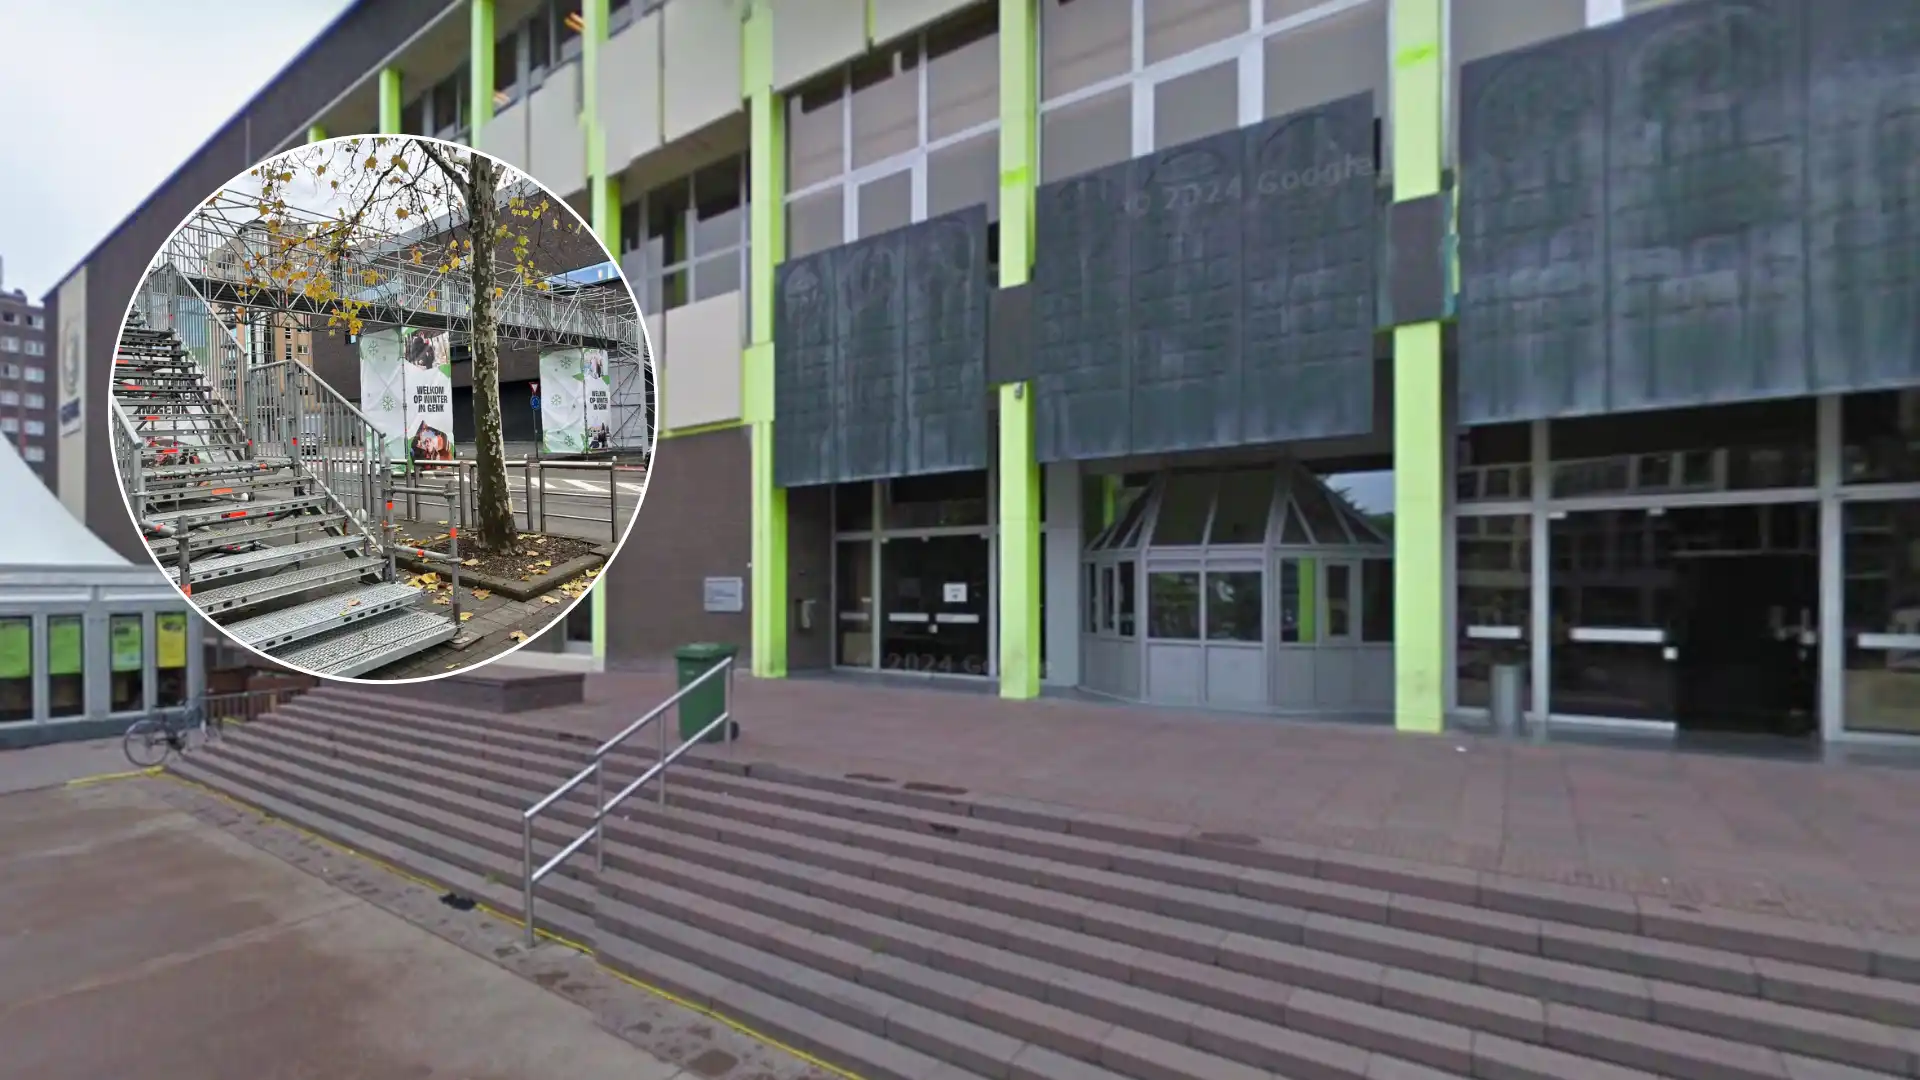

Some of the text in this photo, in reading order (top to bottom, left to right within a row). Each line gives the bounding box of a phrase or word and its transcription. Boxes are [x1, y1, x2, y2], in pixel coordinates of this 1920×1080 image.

[417, 386, 444, 394] WELKOM
[413, 395, 448, 404] OP WINTER
[418, 404, 445, 413] IN GENK
